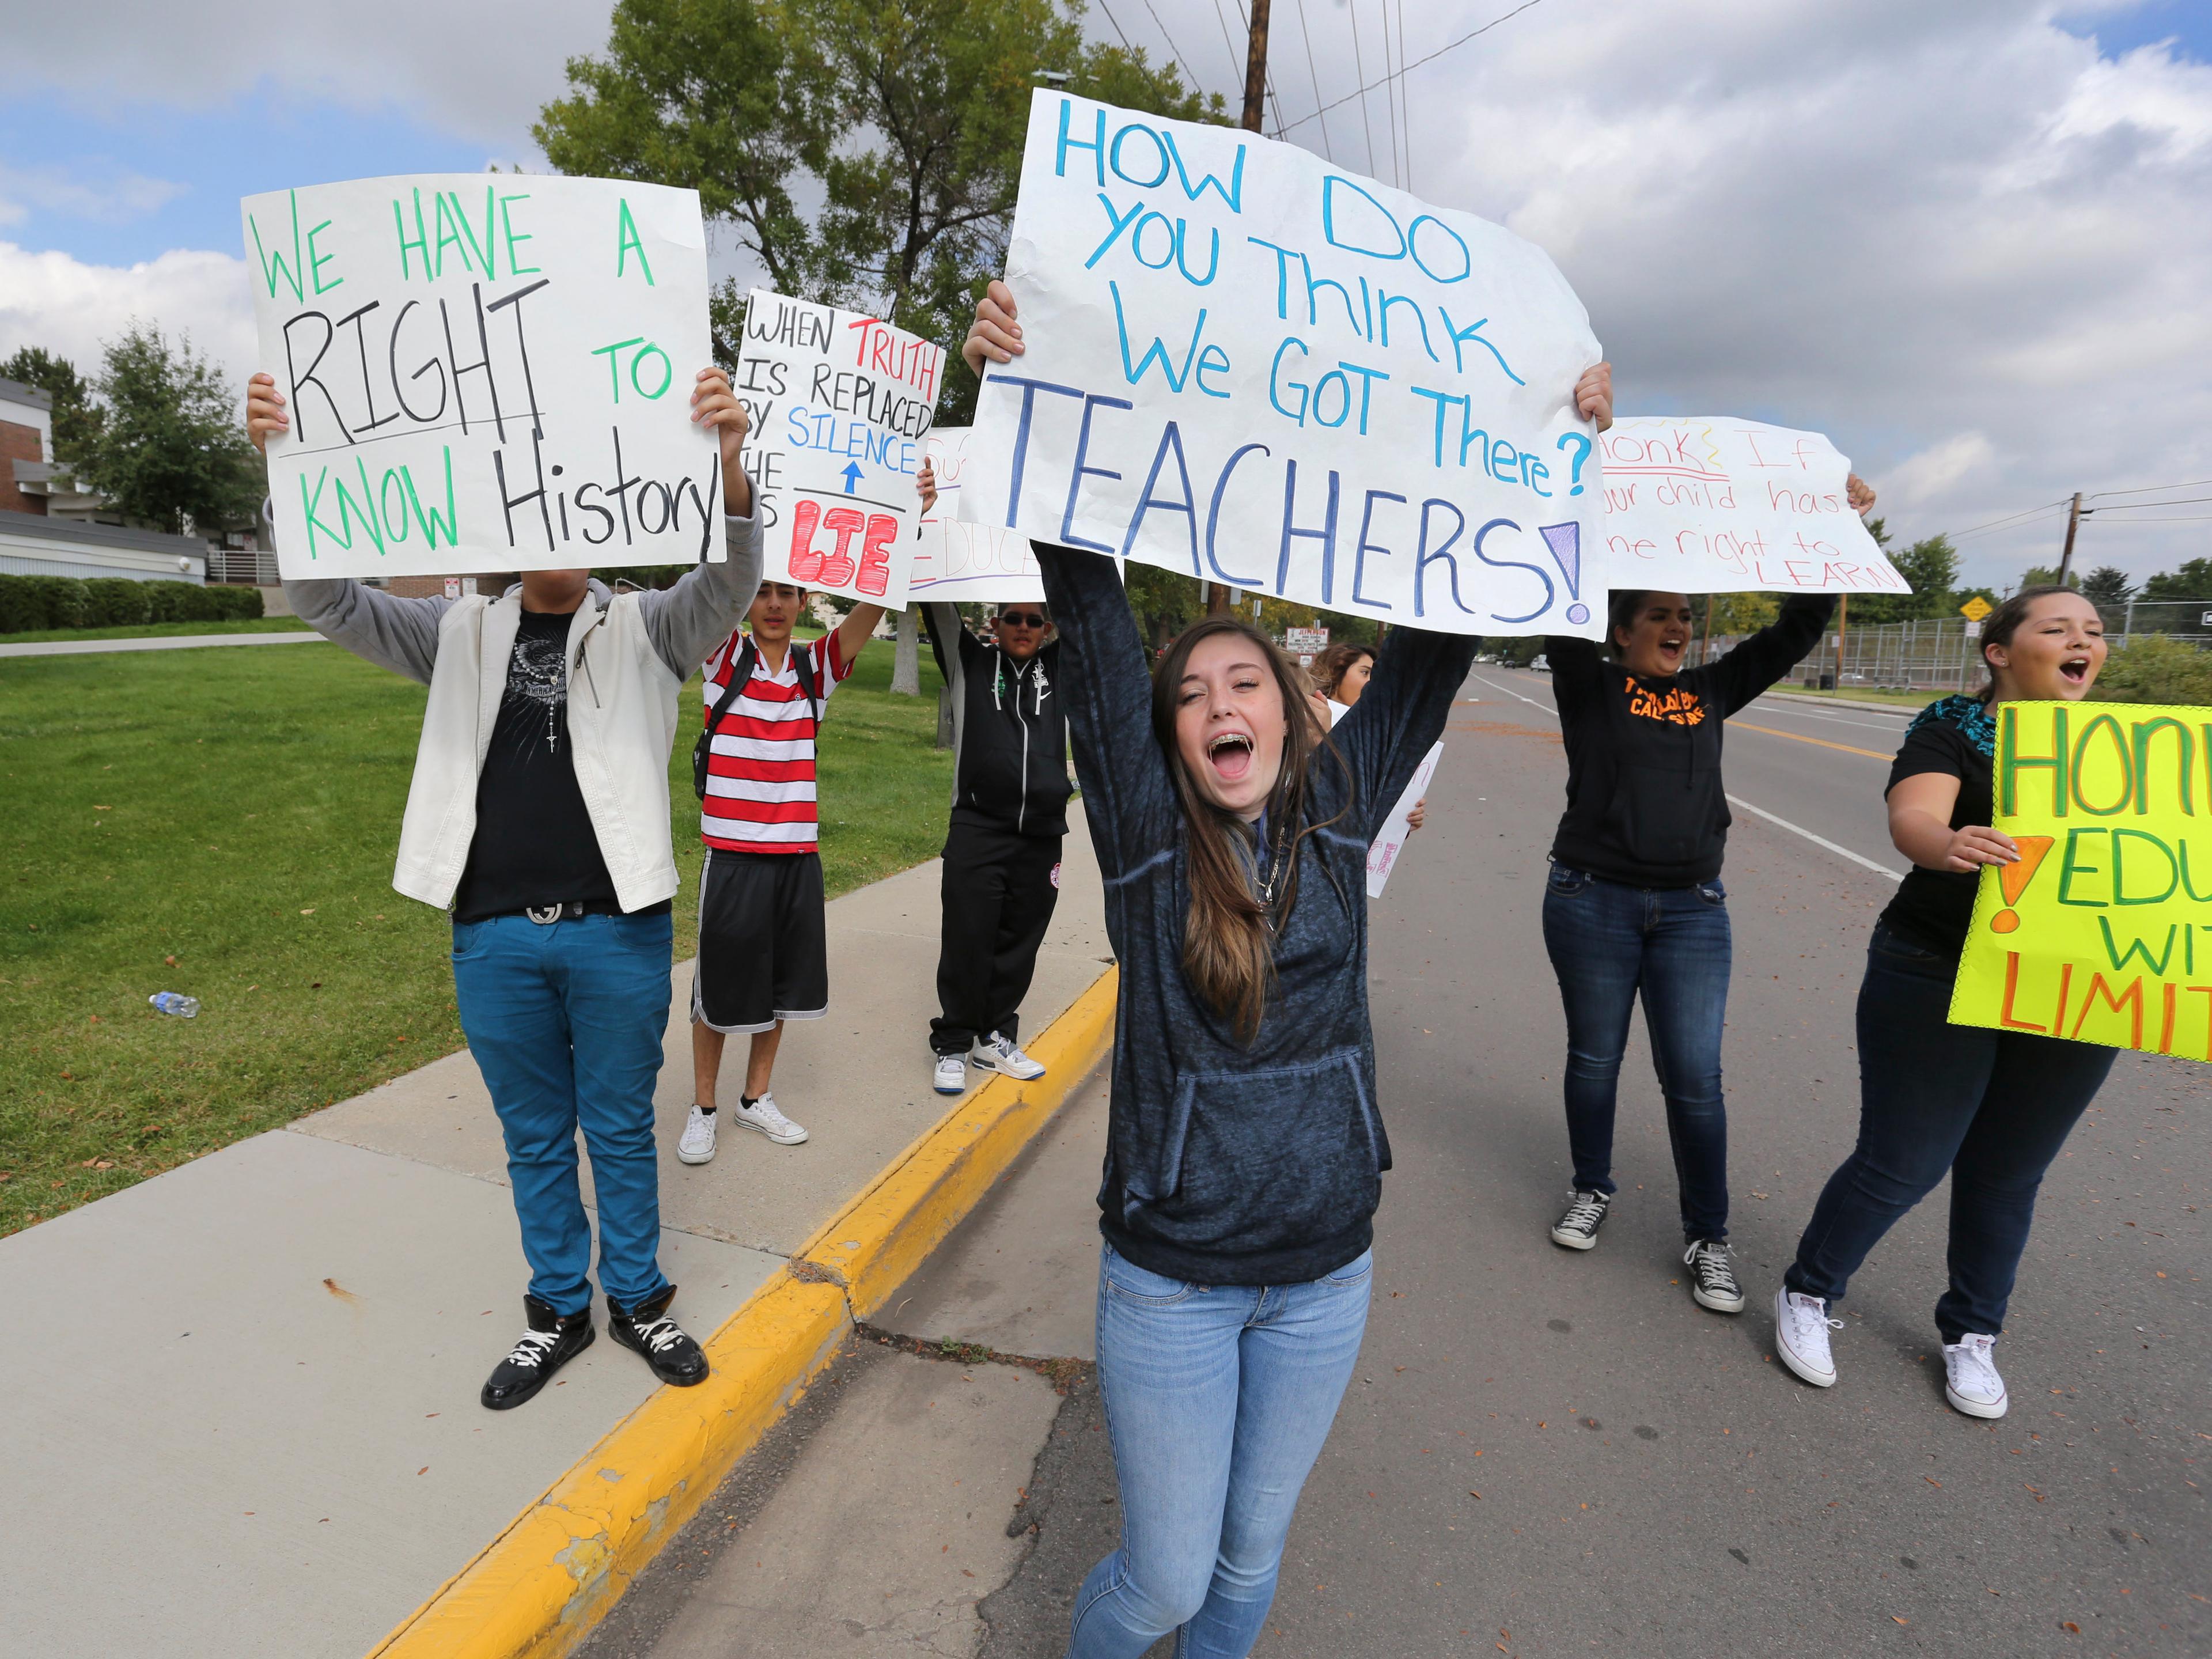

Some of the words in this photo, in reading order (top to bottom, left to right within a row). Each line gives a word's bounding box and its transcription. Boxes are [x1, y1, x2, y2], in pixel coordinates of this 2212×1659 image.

[249, 189, 343, 305] WE
[393, 185, 541, 283] HAVE
[617, 198, 656, 286] A
[1055, 99, 1247, 214] HOW
[1323, 175, 1471, 284] DO
[1084, 192, 1220, 287] YOU
[283, 279, 550, 445] RIGHT
[591, 337, 672, 404] TO
[739, 358, 788, 396] IS
[810, 363, 933, 441] REPLACED
[748, 295, 835, 354] WHEN
[849, 317, 938, 403] TRUTH
[1109, 280, 1231, 399] We
[1268, 336, 1390, 435] GOT
[300, 445, 459, 560] KNOW
[493, 426, 718, 563] History
[787, 406, 916, 475] SILENCE
[787, 499, 899, 597] LIE
[987, 374, 1591, 626] TEACHERS!
[1657, 476, 1736, 510] child
[1767, 480, 1839, 514] has
[1675, 524, 1770, 574] right
[1793, 531, 1840, 556] to
